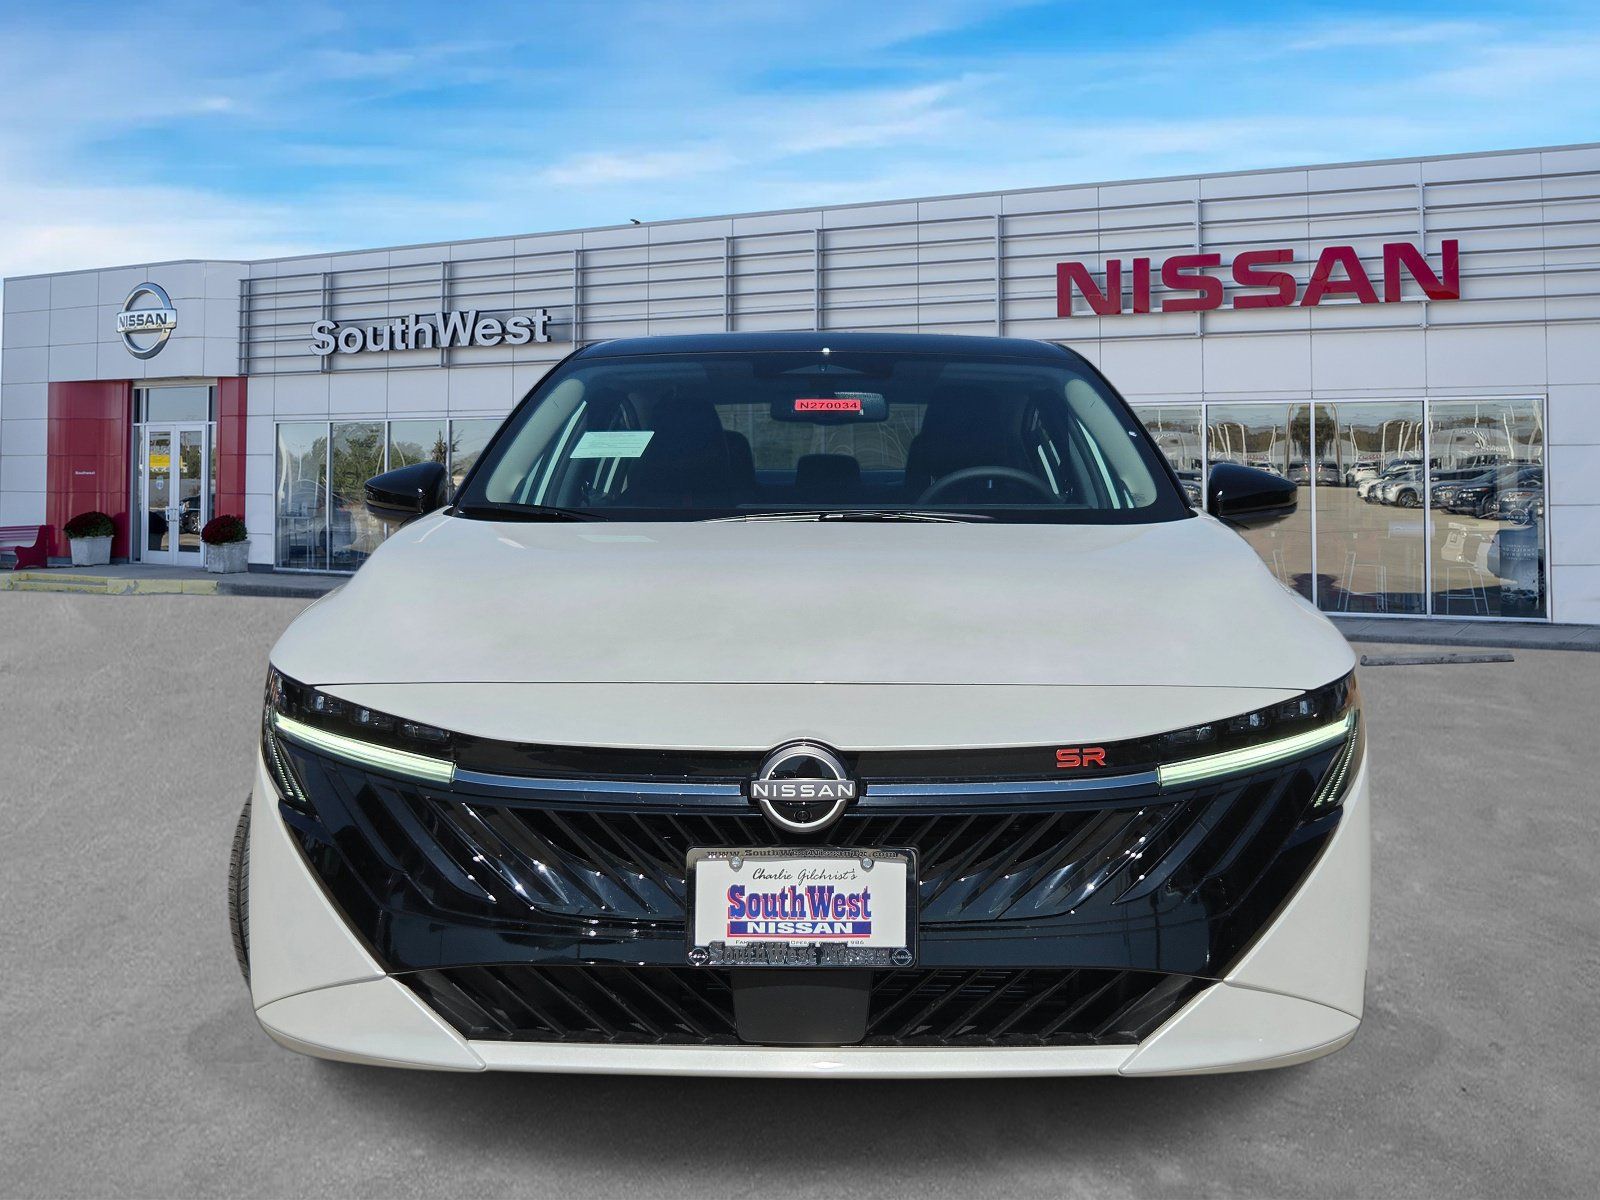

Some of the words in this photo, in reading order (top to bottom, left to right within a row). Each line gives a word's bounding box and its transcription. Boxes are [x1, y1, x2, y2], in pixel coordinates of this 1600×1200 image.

[1057, 239, 1460, 317] NISSAN
[119, 313, 167, 328] NISSAN
[309, 308, 551, 356] SouthWest
[1056, 746, 1106, 768] SR
[753, 783, 853, 798] NISSAN
[752, 868, 793, 880] Charlie
[797, 868, 858, 886] Gilchrist's
[727, 884, 872, 920] SouthWest
[747, 922, 853, 934] NISSAN
